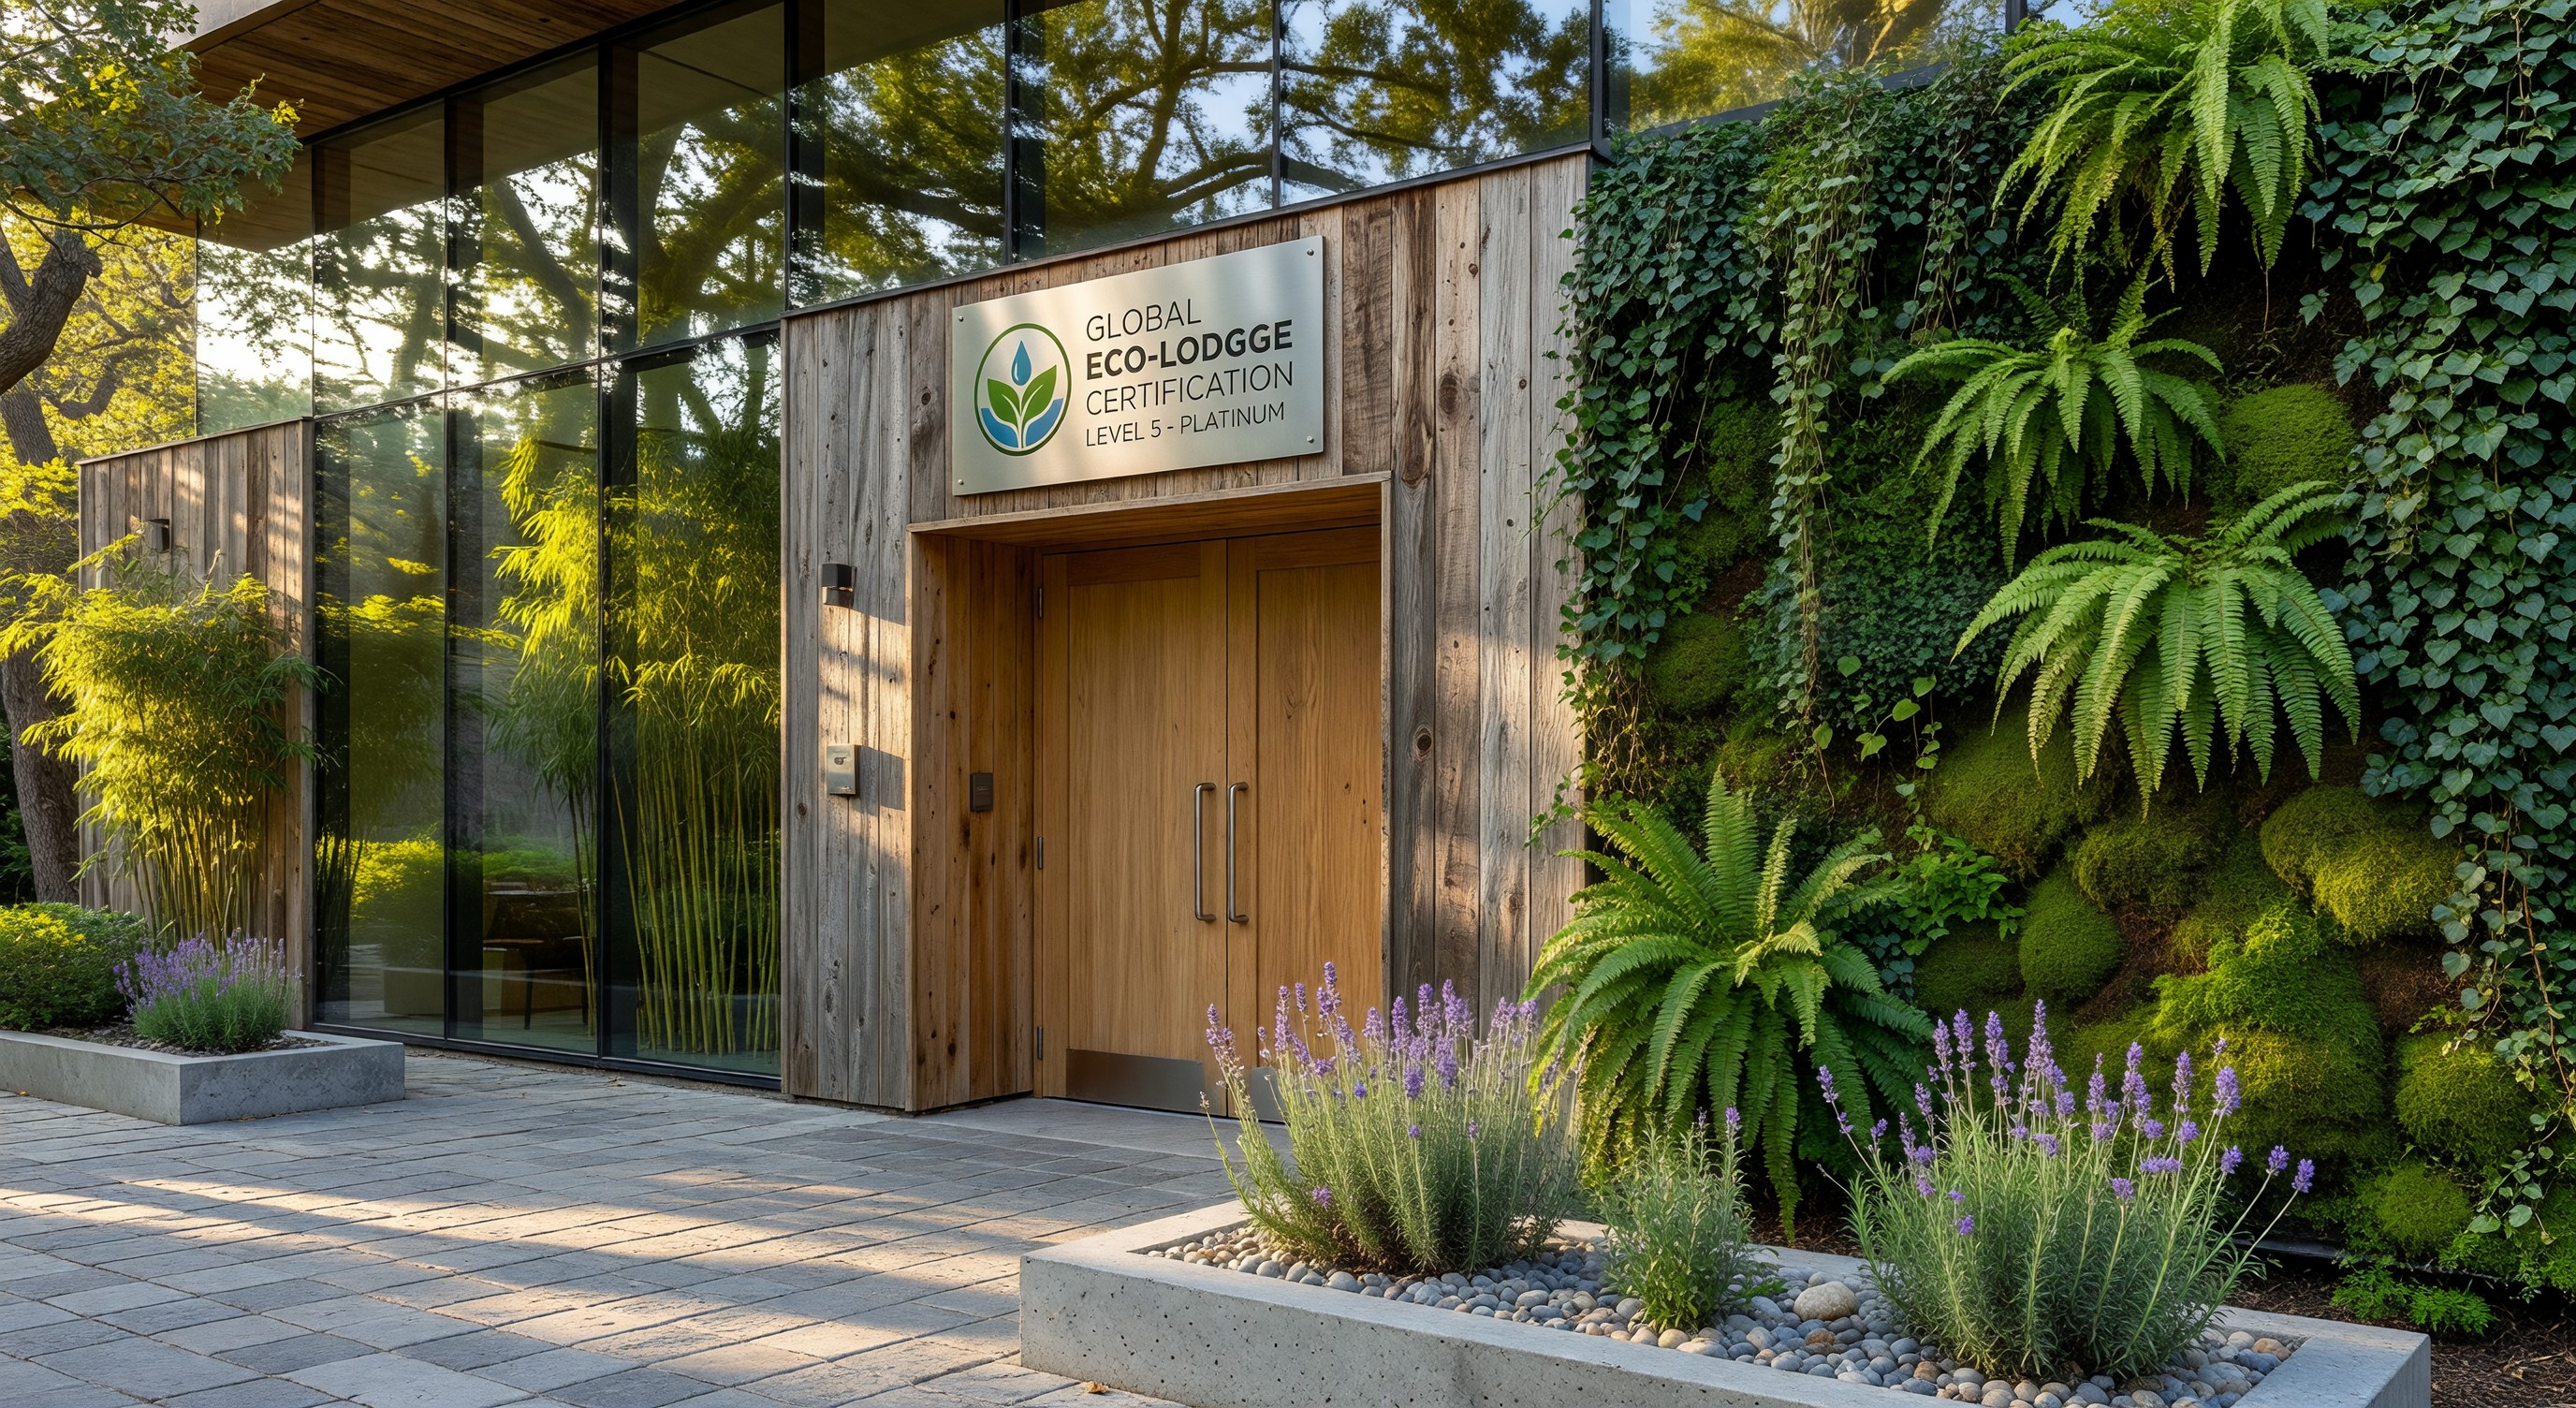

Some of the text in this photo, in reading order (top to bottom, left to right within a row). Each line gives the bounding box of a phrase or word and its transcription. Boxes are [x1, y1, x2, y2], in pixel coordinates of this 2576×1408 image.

[1086, 299, 1202, 342] GLOBAL
[1087, 319, 1293, 380] ECO-LODGGE
[1086, 360, 1293, 416] CERTIFICATION
[1086, 421, 1145, 447] LEVEL
[1150, 418, 1162, 438] 5
[1180, 402, 1285, 434] PLATINUM
